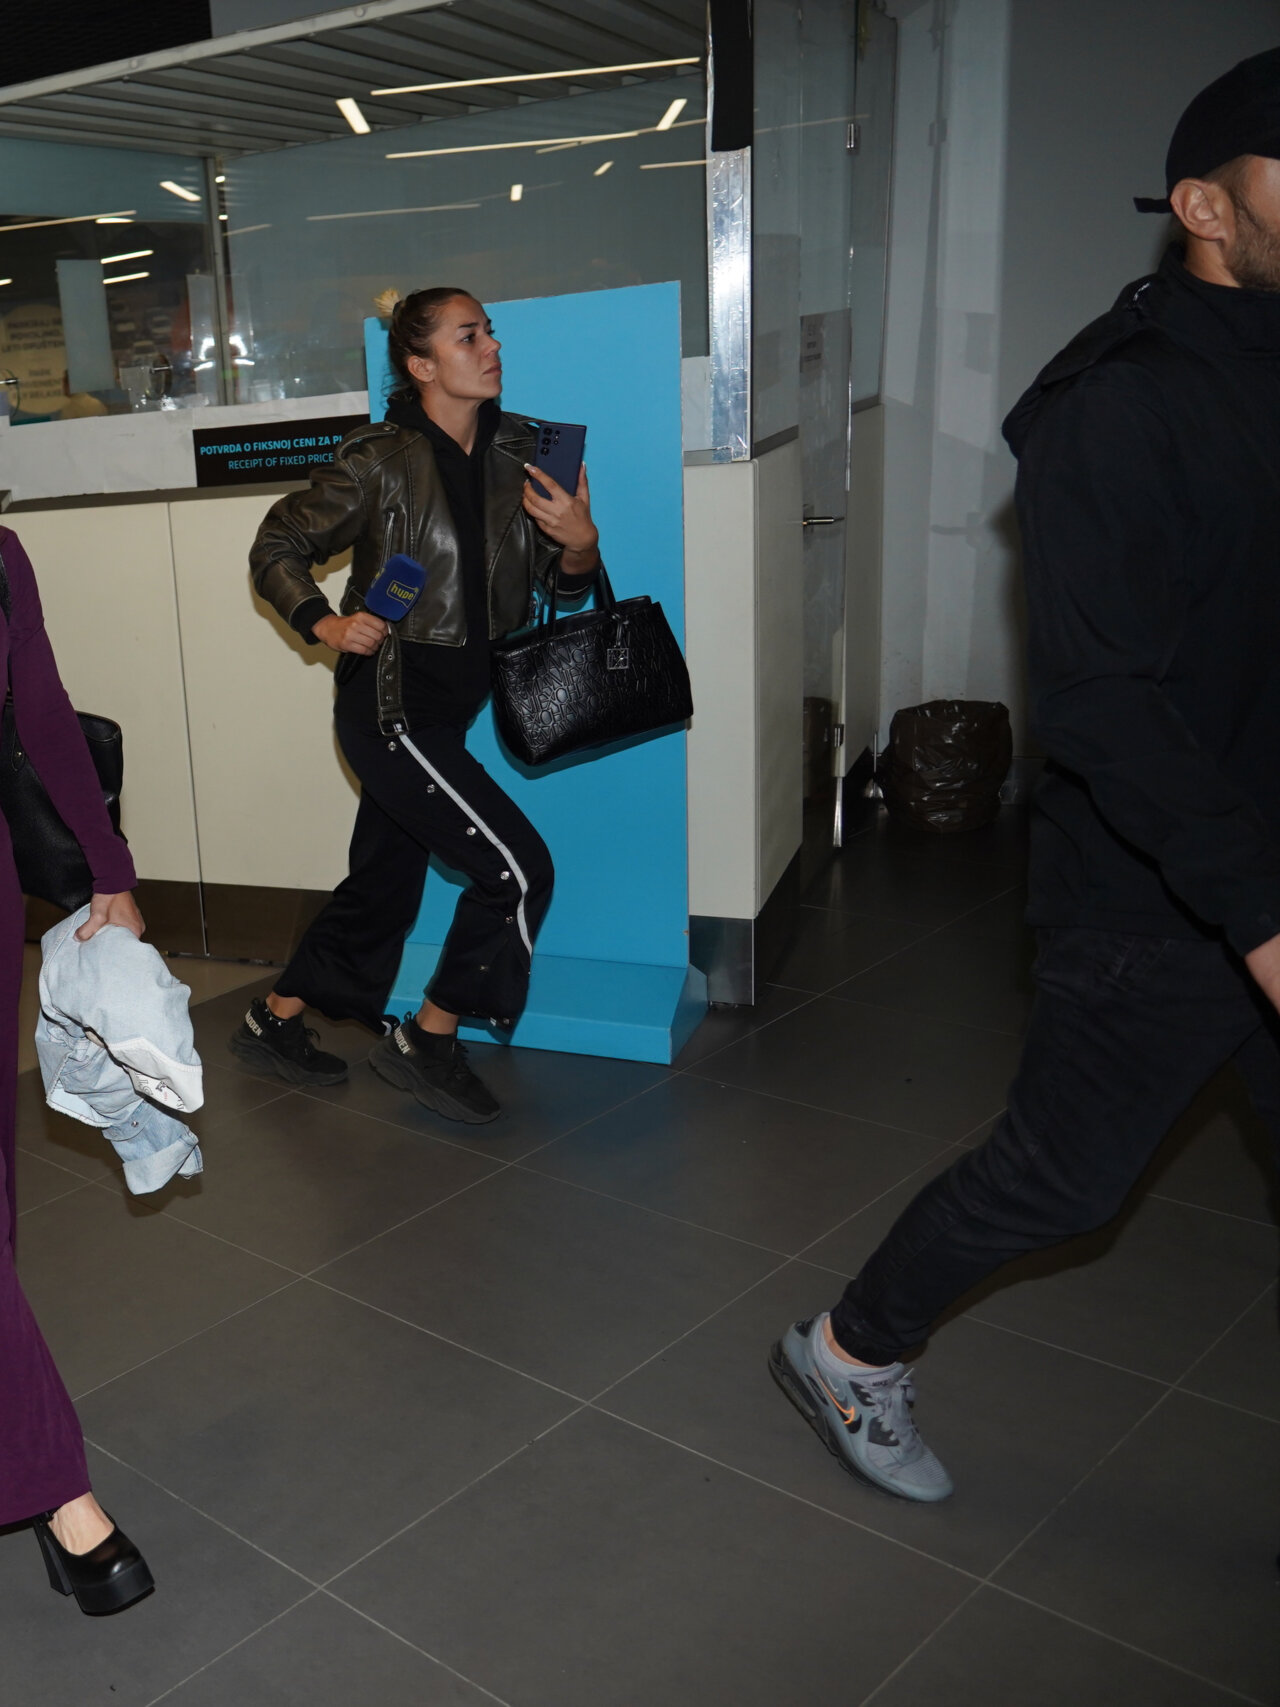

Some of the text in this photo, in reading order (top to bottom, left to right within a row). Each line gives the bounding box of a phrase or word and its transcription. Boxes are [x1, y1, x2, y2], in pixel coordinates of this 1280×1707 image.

[200, 443, 242, 455] POTVRDA
[244, 442, 252, 452] O
[253, 439, 291, 451] FIKSNOJ
[293, 437, 316, 448] CENI
[318, 435, 331, 446] ZA
[228, 453, 334, 470] RECEIPT OF FIXED PRICE
